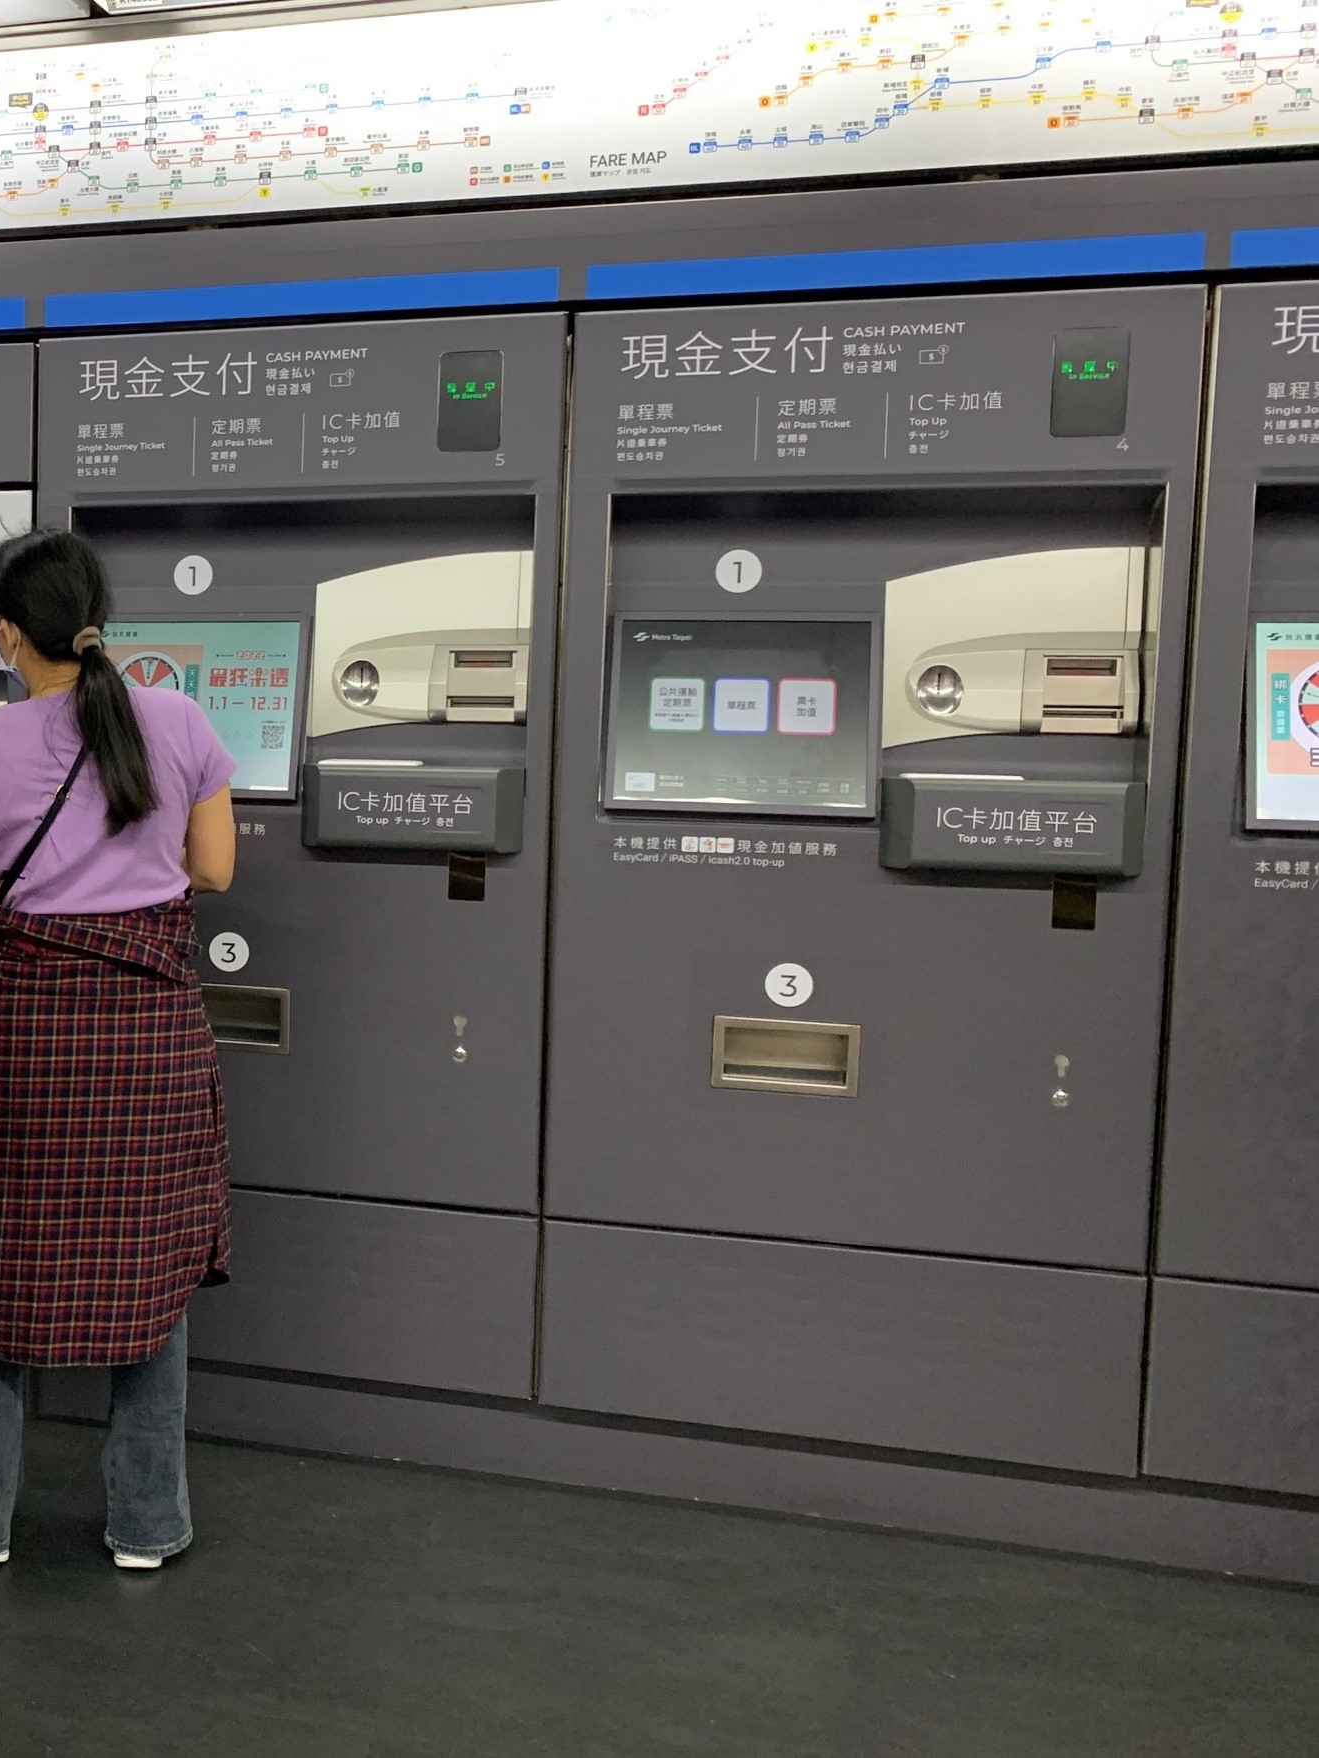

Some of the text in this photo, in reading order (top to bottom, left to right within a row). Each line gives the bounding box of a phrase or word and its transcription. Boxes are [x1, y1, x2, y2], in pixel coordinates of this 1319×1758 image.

[590, 151, 667, 168] FARE MAP
[844, 322, 966, 339] CASH PAYMENT
[266, 348, 368, 363] CASH PAYMENT
[620, 326, 834, 380] 現金支付
[843, 342, 902, 358] 現金払い
[266, 366, 315, 380] 現金払い
[843, 360, 897, 375] 현금결제
[79, 351, 258, 401] 現金支付
[266, 383, 311, 397] 현금결제
[777, 397, 837, 418] 定期票
[909, 390, 1003, 412] IC卡加值
[618, 402, 675, 422] 單程票
[1265, 406, 1301, 417] Single
[211, 417, 262, 435] 定期票
[322, 411, 401, 431] IC卡加值
[777, 419, 851, 430] All Pass Ticket
[909, 416, 947, 428] Top Up
[78, 422, 125, 440] 單程票
[617, 423, 723, 437] Single Journey Ticket
[909, 429, 949, 441] チャージ
[211, 437, 273, 448] All Pass Ticket
[322, 434, 354, 445] Top Up
[1116, 437, 1130, 452] 4
[77, 441, 165, 454] Single Journey Ticket
[322, 446, 357, 457] チャージ
[495, 453, 505, 467] 5
[188, 566, 196, 587] 1
[733, 561, 744, 583] 1
[651, 633, 692, 642] Metro Taipei
[236, 650, 266, 660] 2022
[251, 696, 288, 711] 12.31
[663, 698, 692, 708] 定期票
[727, 700, 756, 710] 單程票
[797, 696, 817, 706] 票卡
[796, 707, 817, 718] 加值
[338, 791, 474, 814] IC卡加值平台
[356, 815, 389, 827] Top up
[394, 816, 430, 826] チャージ
[936, 806, 1098, 834] IC卡加值平台
[232, 823, 266, 836] 服務
[613, 836, 838, 857] 本機提供 現金加值服務
[957, 833, 996, 847] Top up
[1003, 834, 1046, 846] チャージ
[613, 852, 785, 868] EasyCard iPASS icash2.0 top-up
[1254, 860, 1319, 875] 本機提
[1254, 877, 1309, 890] EasyCard
[220, 940, 237, 965] 3
[778, 973, 799, 998] 3
